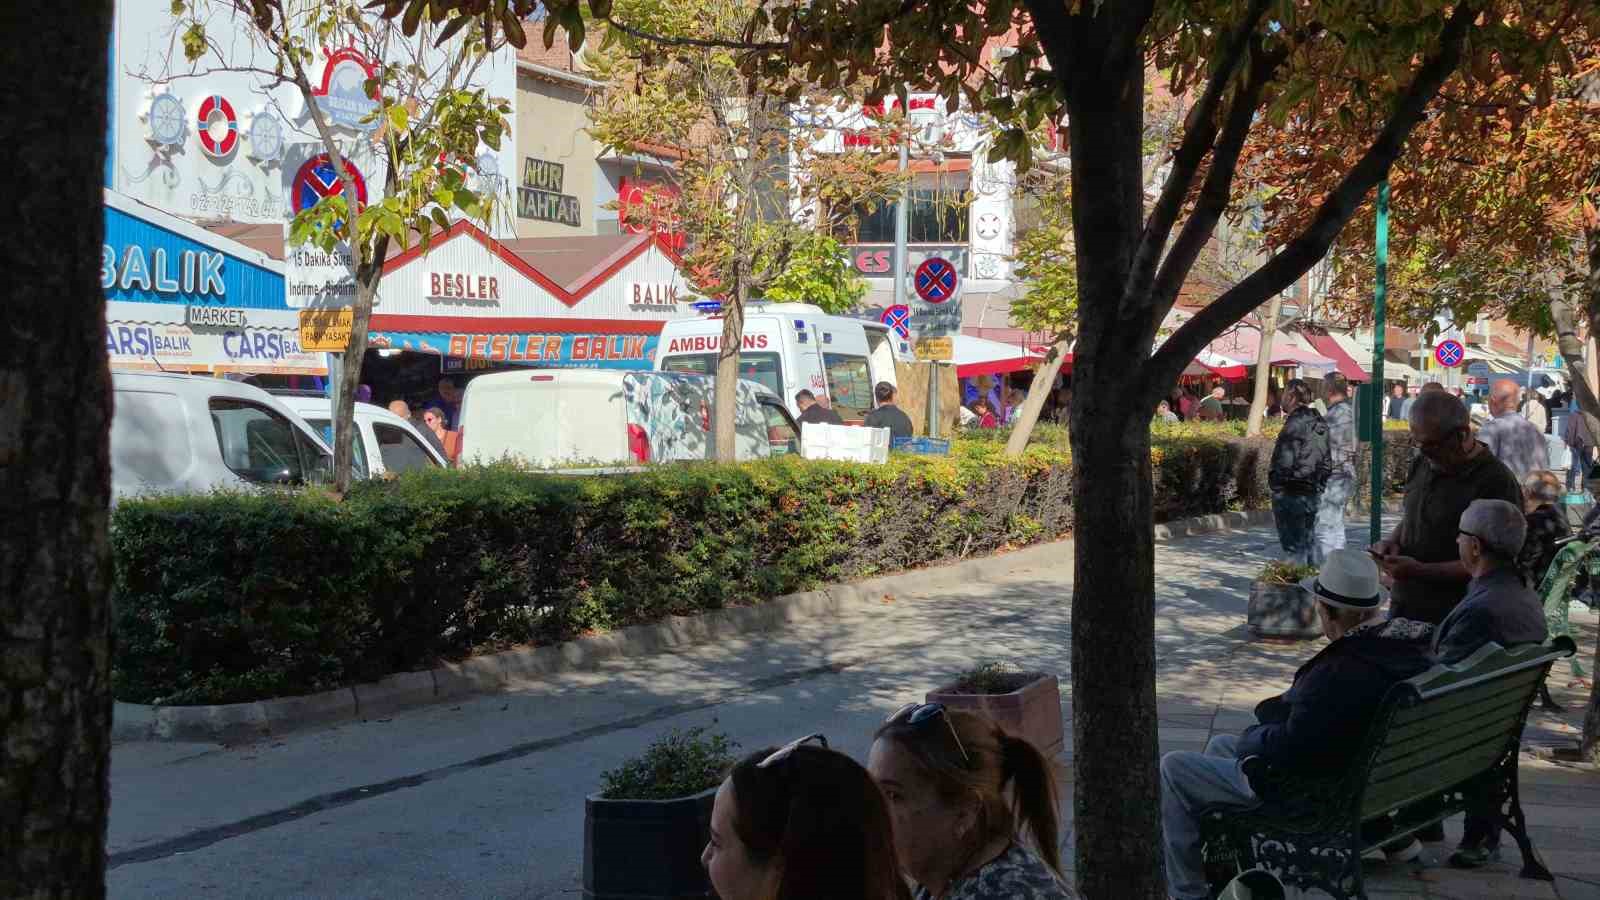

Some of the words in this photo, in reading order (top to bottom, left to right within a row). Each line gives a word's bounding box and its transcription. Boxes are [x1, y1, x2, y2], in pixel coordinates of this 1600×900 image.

[293, 251, 303, 267] 15
[304, 251, 331, 267] Dakika
[102, 244, 226, 296] BALIK
[431, 272, 499, 299] BESLER
[633, 283, 679, 304] BALIK
[191, 308, 244, 324] MARKET
[155, 336, 192, 350] BALIK
[449, 335, 562, 360] BESLER
[572, 335, 647, 360] BALIK
[668, 334, 768, 352] AMBUNS
